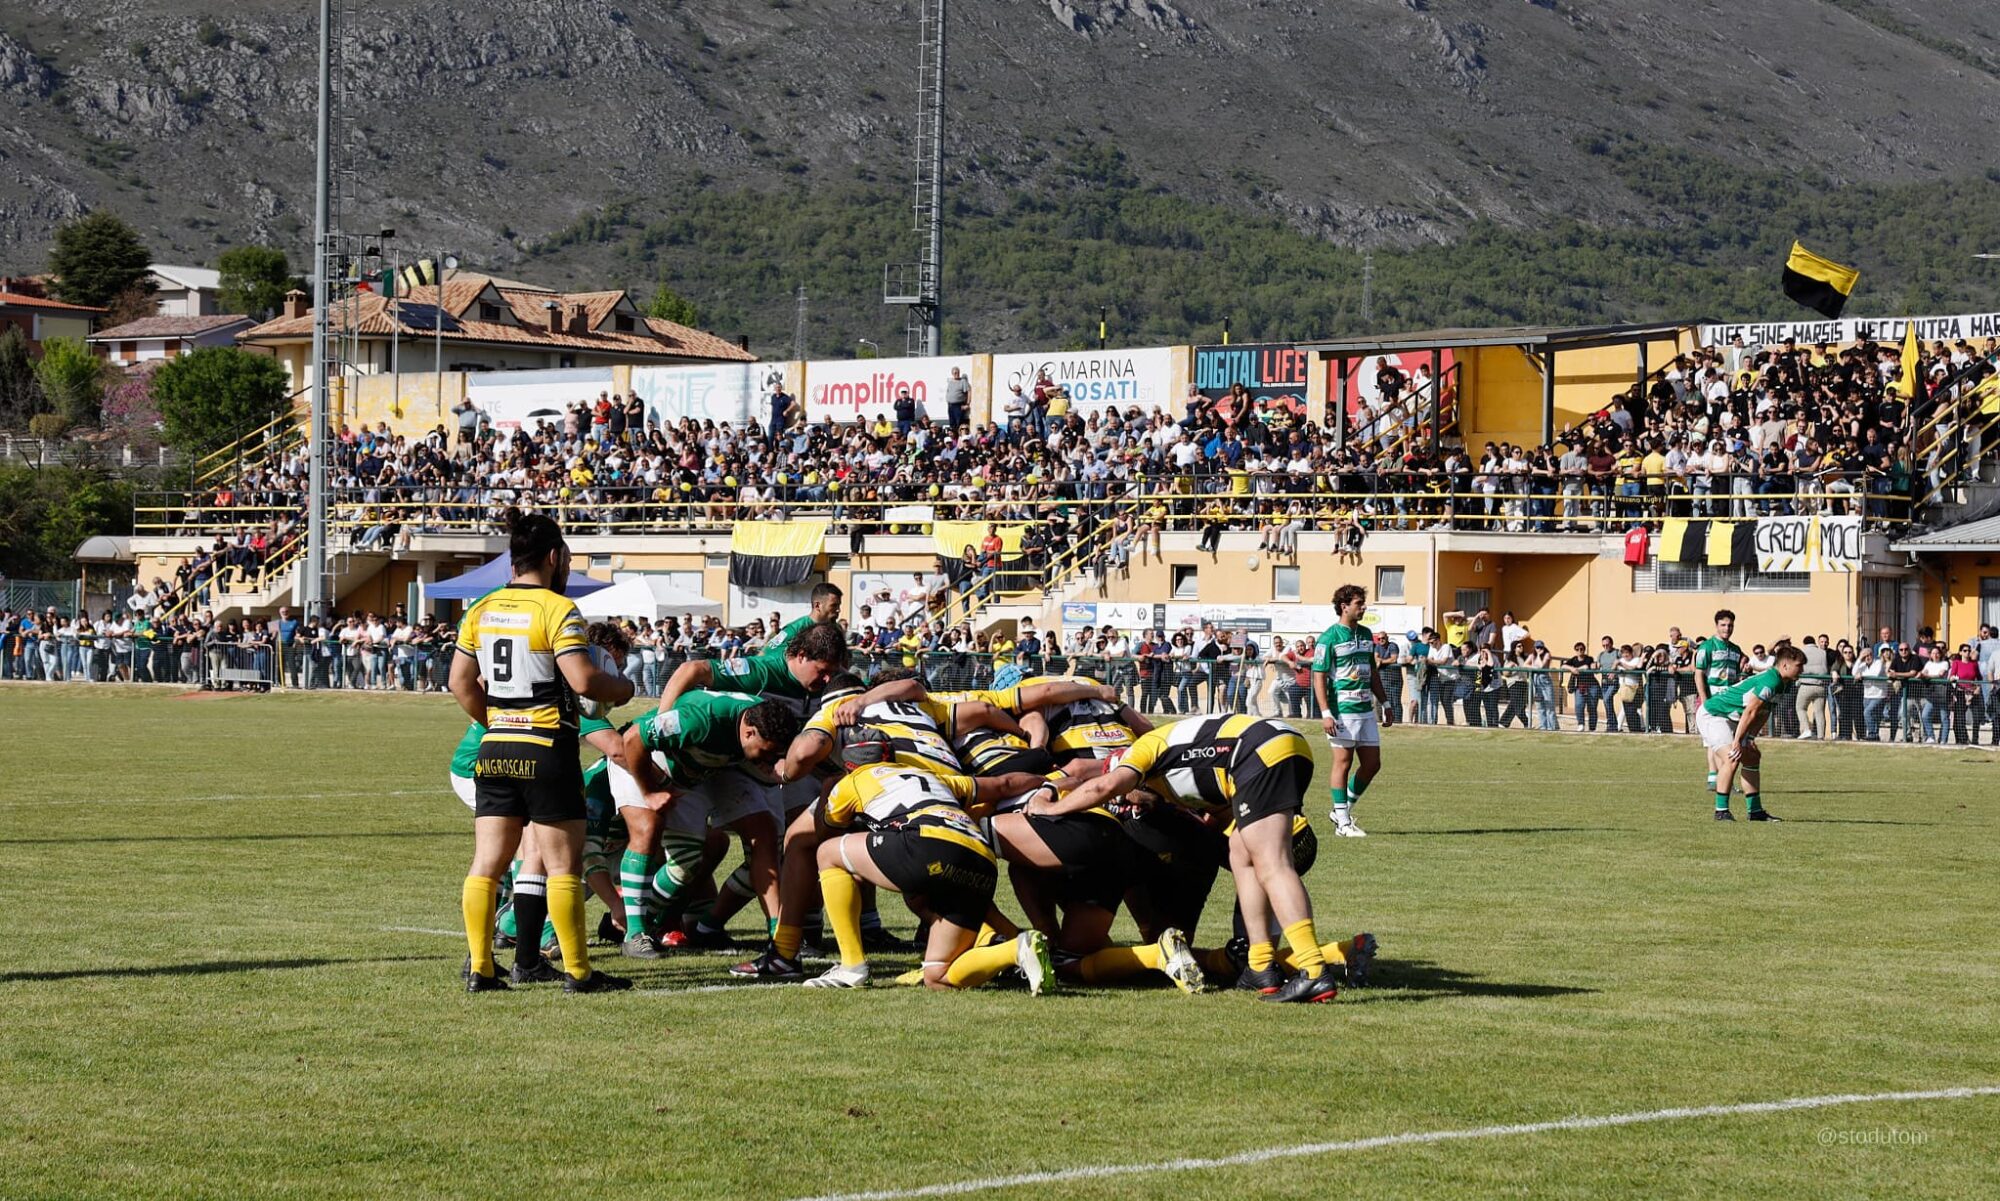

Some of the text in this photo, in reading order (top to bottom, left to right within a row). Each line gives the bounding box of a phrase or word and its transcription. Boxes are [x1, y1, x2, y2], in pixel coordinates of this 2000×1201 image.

[1060, 358, 1135, 380] MARINA
[1198, 349, 1306, 389] DIGITAL LIFE
[812, 372, 927, 413] amplifon
[493, 638, 513, 682] 9
[482, 759, 537, 775] INGROSCART
[899, 774, 931, 793] 7
